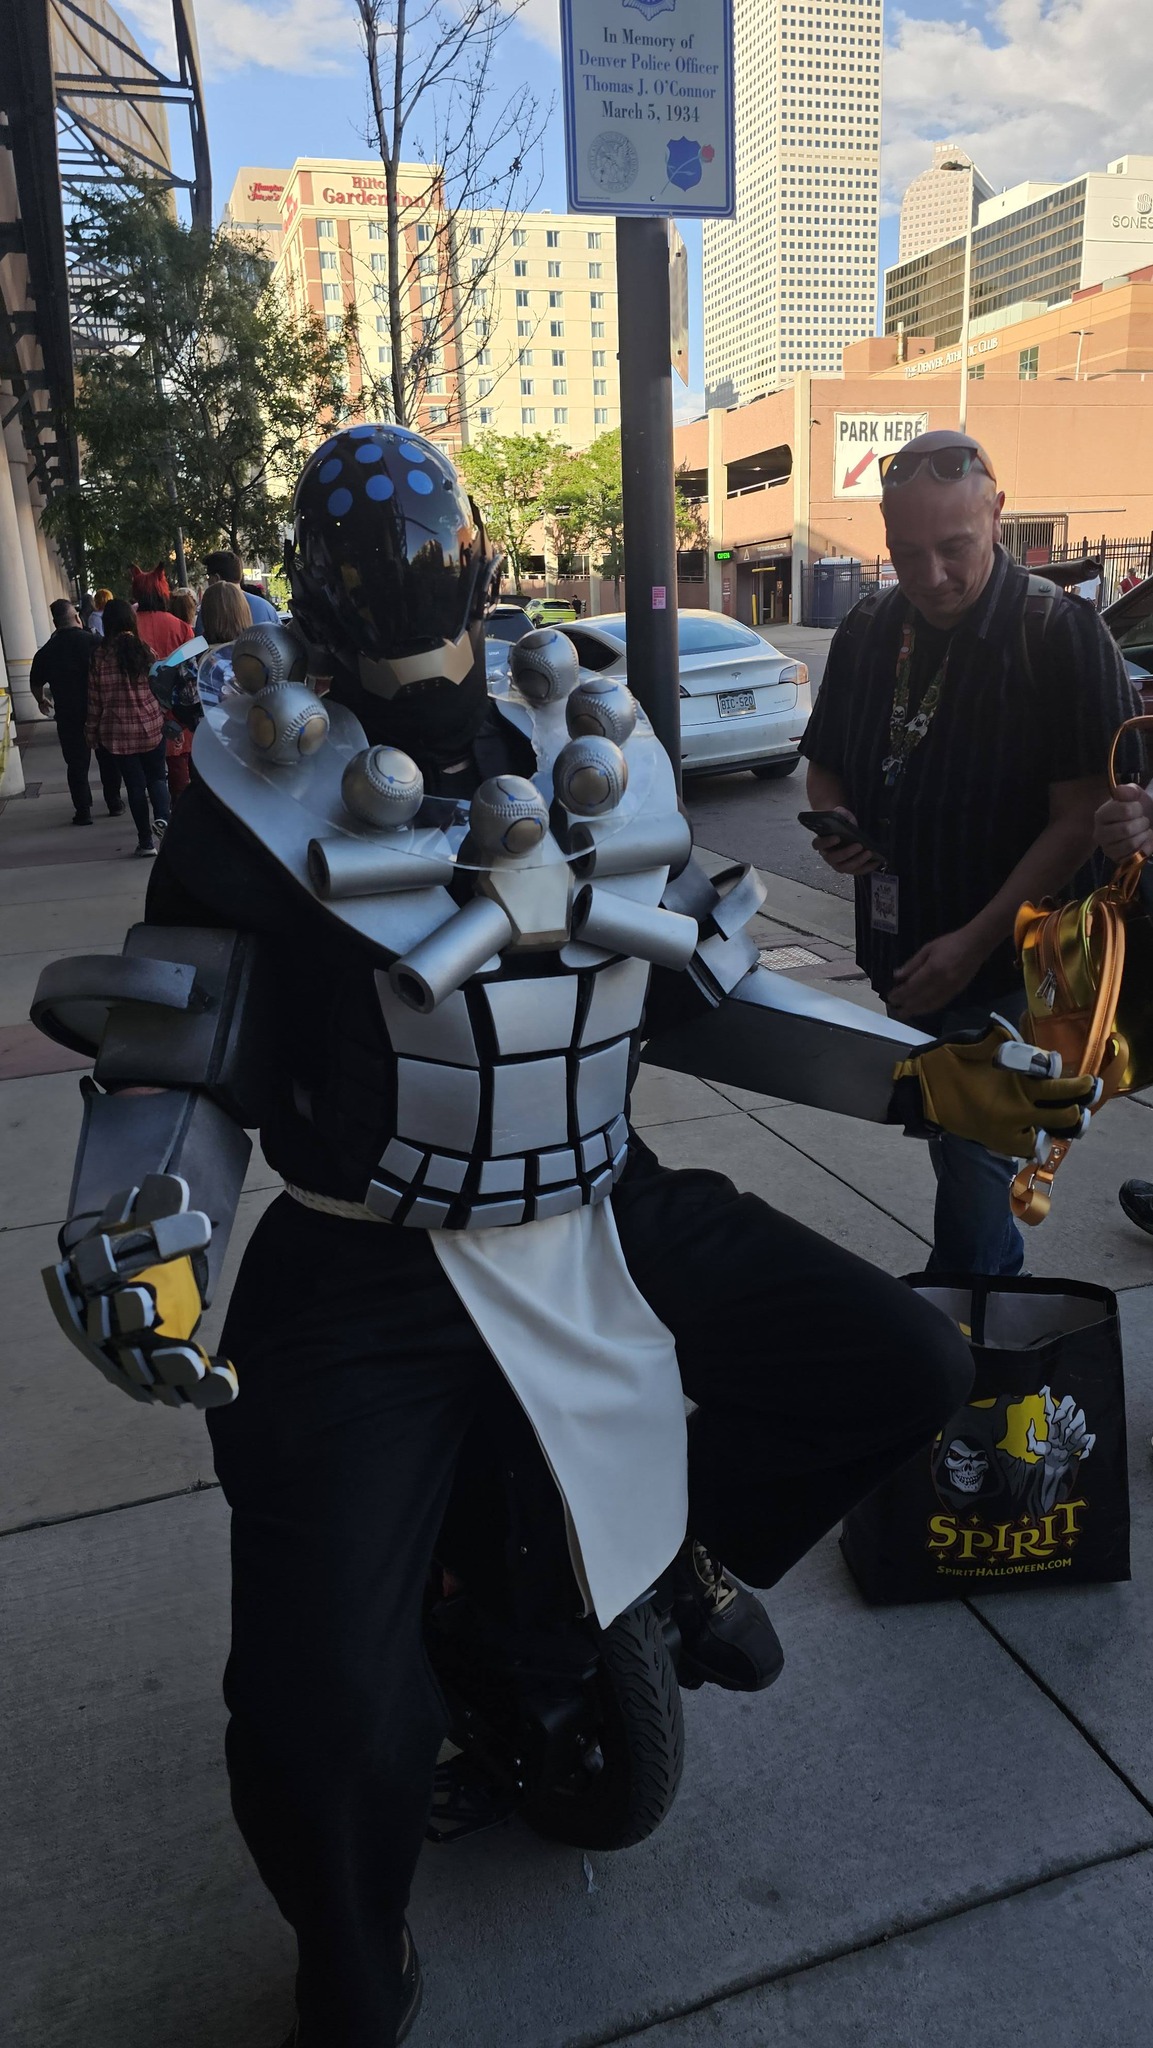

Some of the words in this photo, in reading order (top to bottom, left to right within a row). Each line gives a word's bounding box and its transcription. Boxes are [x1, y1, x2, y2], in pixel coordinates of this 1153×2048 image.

[603, 26, 617, 44] In
[622, 28, 676, 52] Memory
[680, 34, 695, 50] of
[579, 49, 627, 69] Denver
[631, 53, 671, 72] Police
[675, 56, 719, 75] Officer
[583, 74, 634, 94] Thomas
[637, 78, 649, 97] J.
[653, 79, 717, 99] O'Connor
[602, 100, 643, 120] March
[648, 103, 661, 122] 5,
[667, 104, 700, 123] 1934
[351, 176, 386, 190] Hilto
[322, 187, 388, 206] Garden
[918, 356, 944, 375] DENVER
[978, 337, 998, 353] CLUB
[839, 420, 879, 442] PARK
[927, 1499, 1088, 1560] SPIRIT
